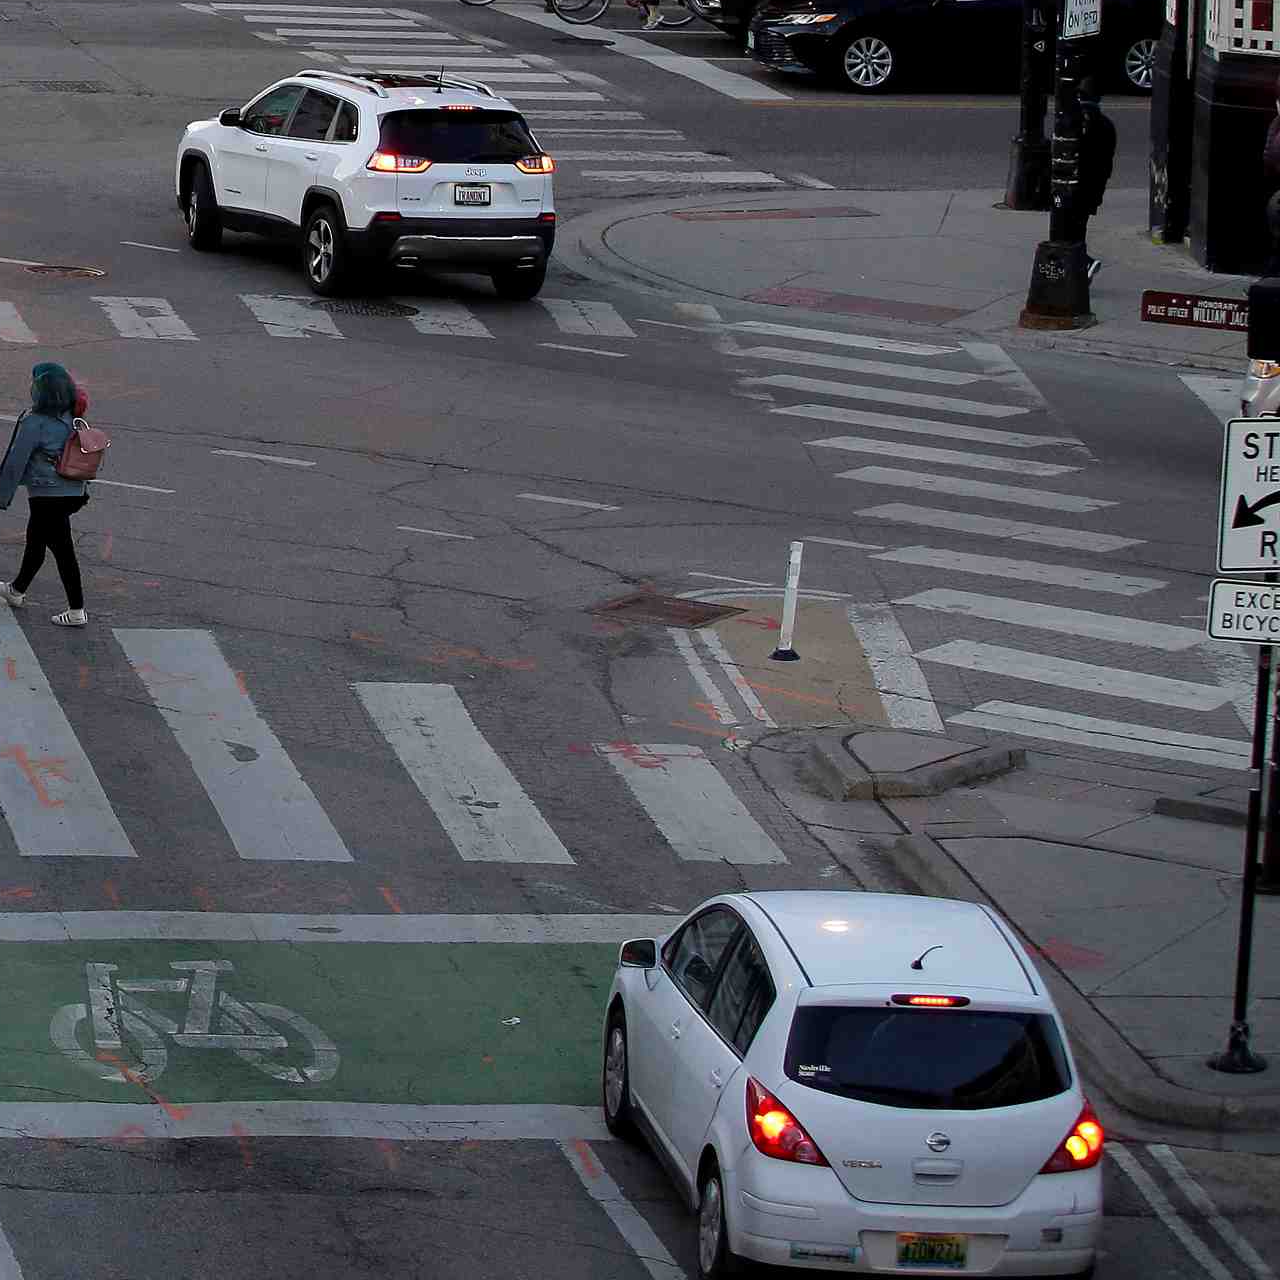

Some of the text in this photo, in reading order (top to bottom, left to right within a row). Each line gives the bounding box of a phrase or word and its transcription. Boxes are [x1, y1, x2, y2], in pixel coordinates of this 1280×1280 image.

[1068, 14, 1081, 28] ON
[1192, 306, 1227, 325] WILLIAM
[1242, 432, 1280, 460] ST
[1256, 466, 1280, 482] HE
[1234, 591, 1280, 610] EXCE
[1221, 612, 1280, 633] BICYC
